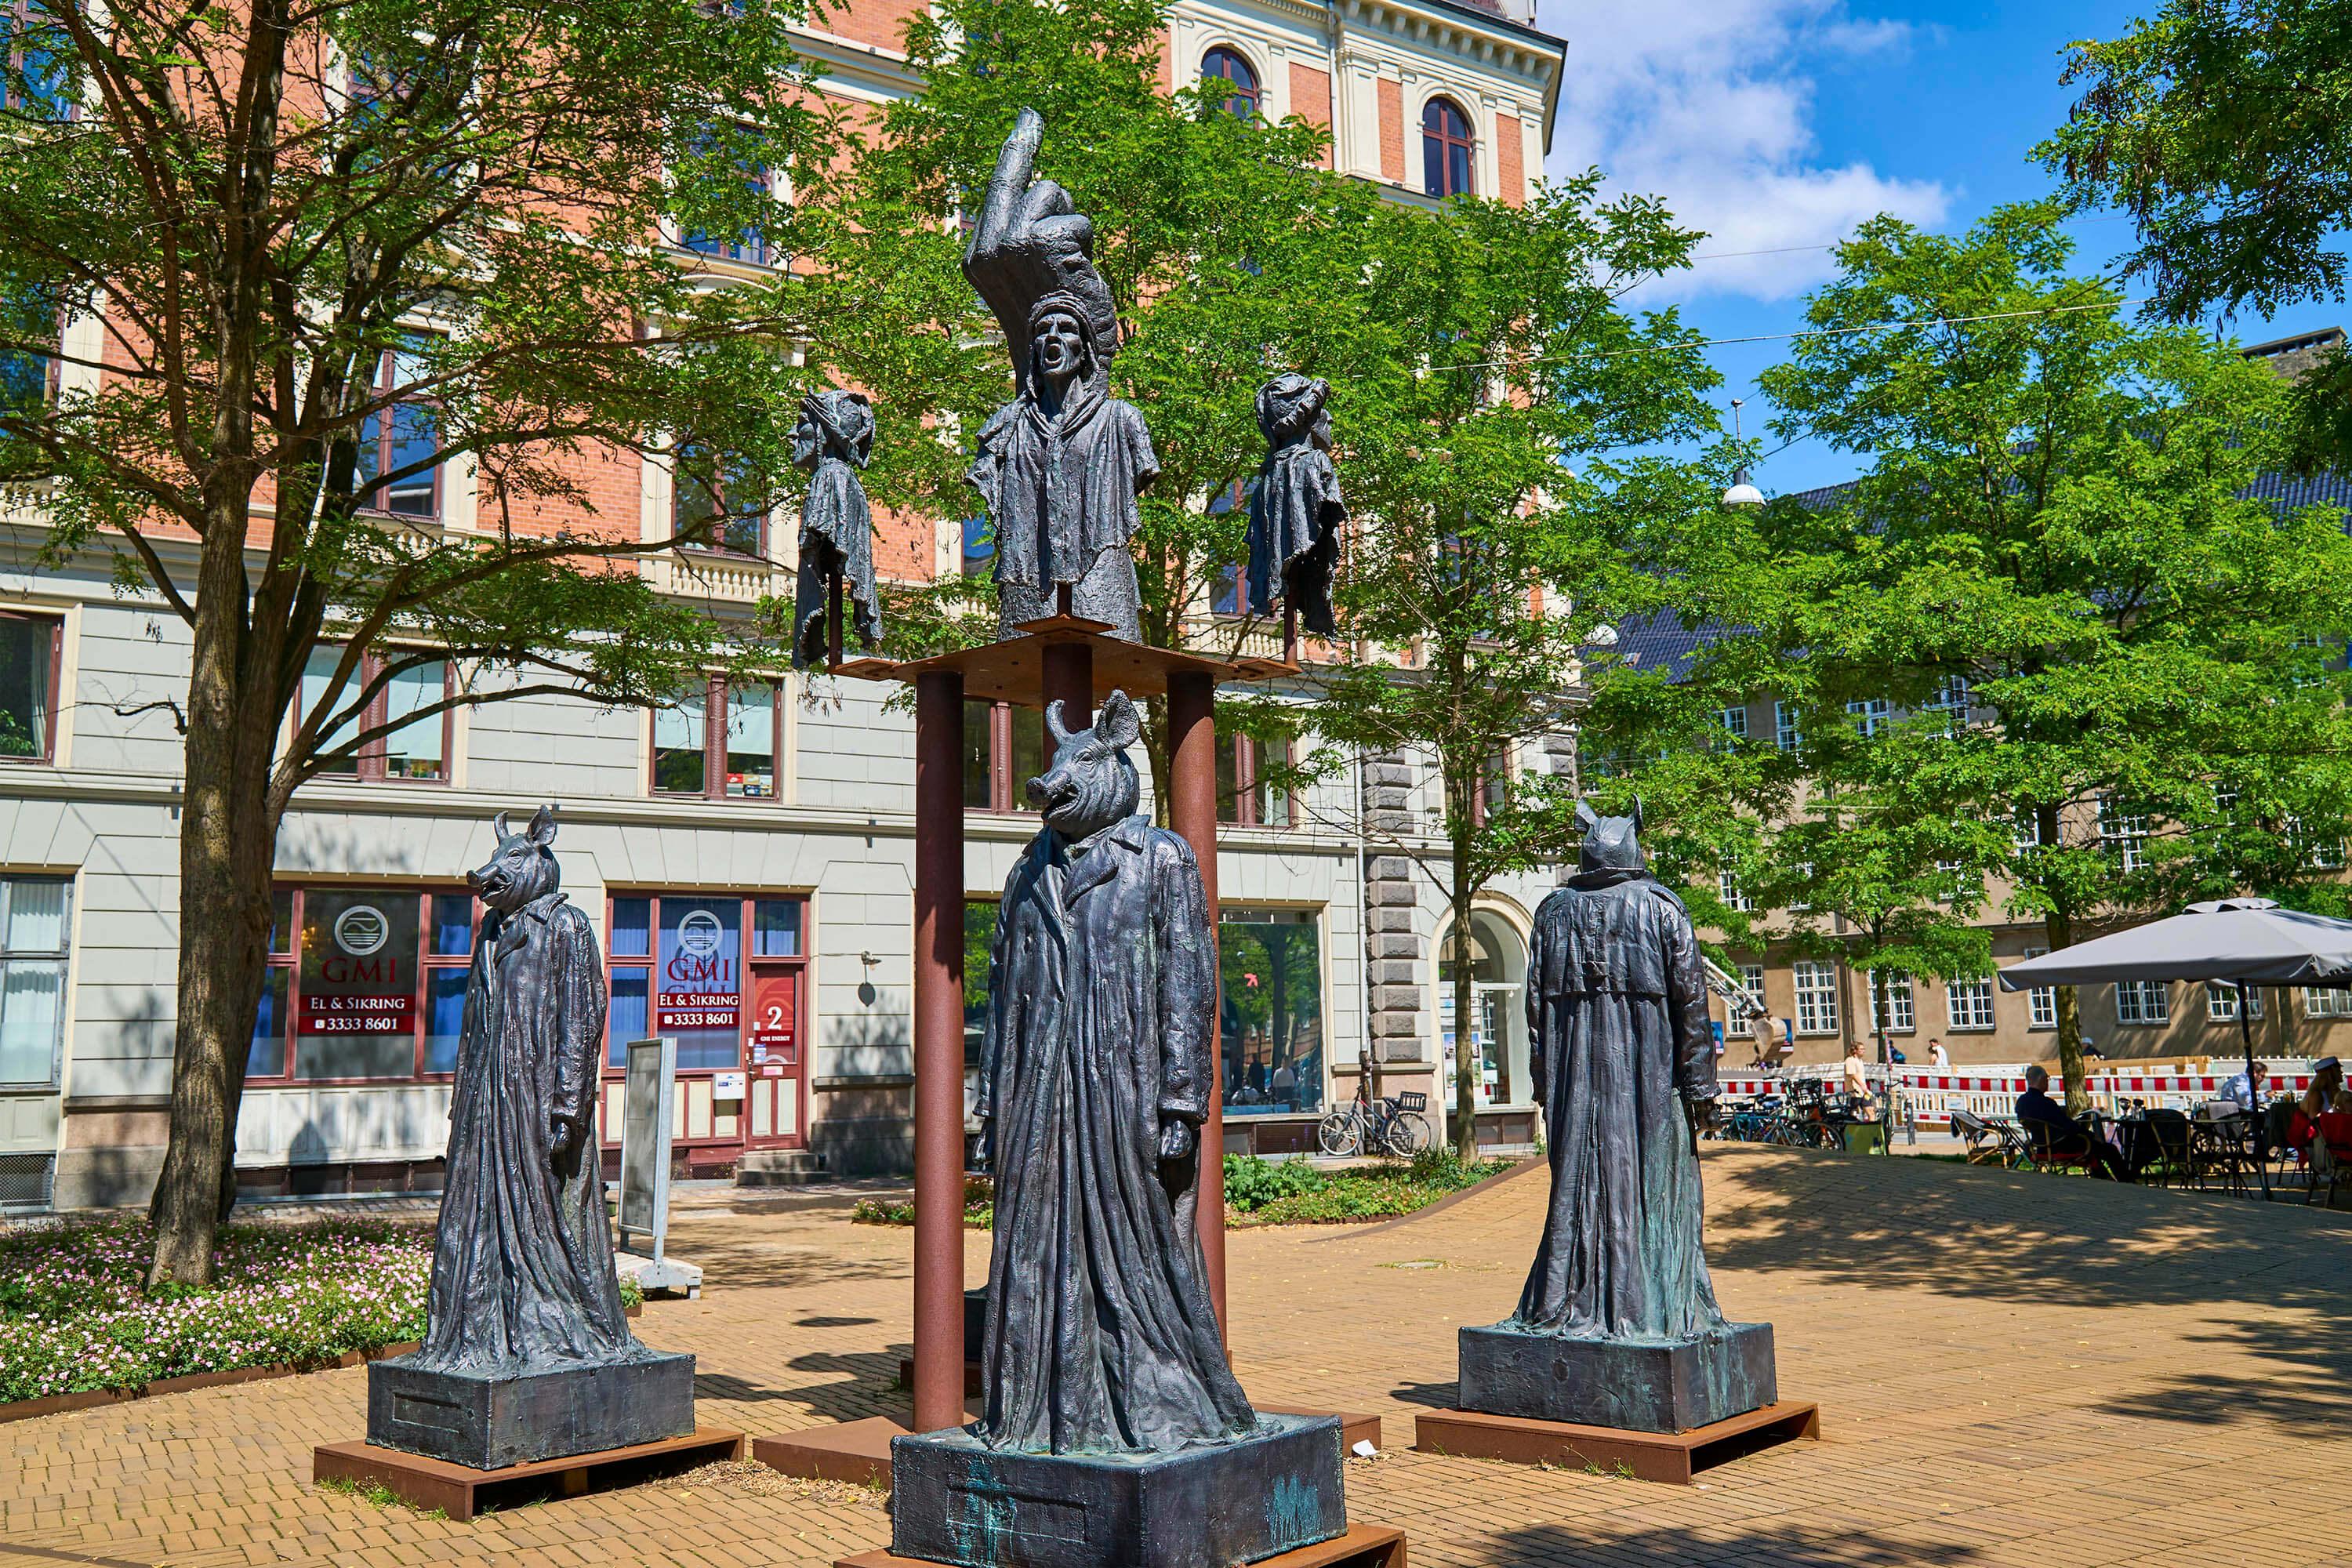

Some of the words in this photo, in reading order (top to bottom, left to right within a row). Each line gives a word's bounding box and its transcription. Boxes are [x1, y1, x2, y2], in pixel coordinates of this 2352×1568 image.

[321, 955, 397, 983] GMI
[667, 958, 731, 981] GMI
[331, 997, 343, 1009] &
[676, 994, 687, 1006] &
[327, 1018, 361, 1030] 3333
[365, 1018, 397, 1030] 8601
[674, 1013, 702, 1025] 3333
[706, 1013, 734, 1025] 8601
[768, 1006, 782, 1030] 2
